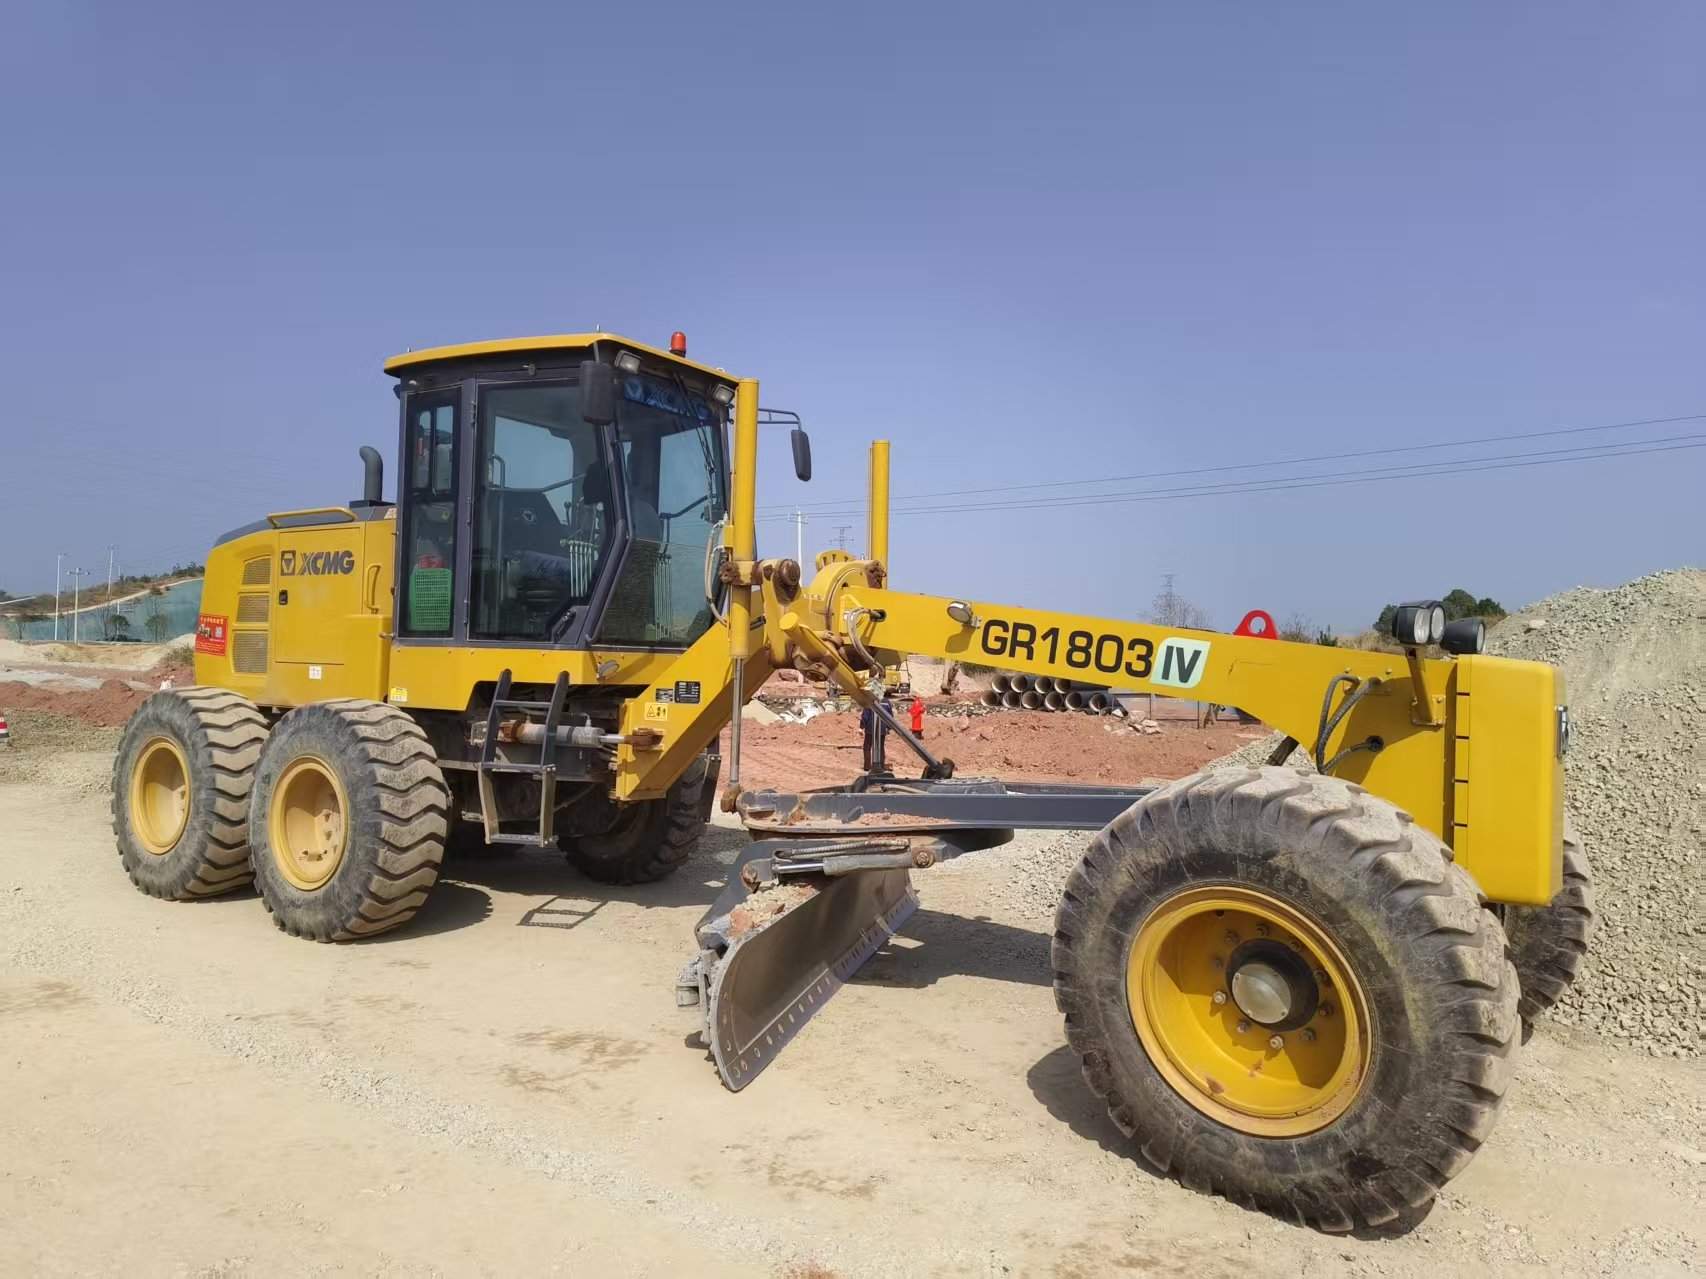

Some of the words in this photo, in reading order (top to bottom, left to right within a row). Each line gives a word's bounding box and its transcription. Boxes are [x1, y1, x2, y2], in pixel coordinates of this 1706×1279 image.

[297, 551, 355, 575] XCMG
[981, 619, 1154, 678] GR1803
[1161, 645, 1202, 683] IV
